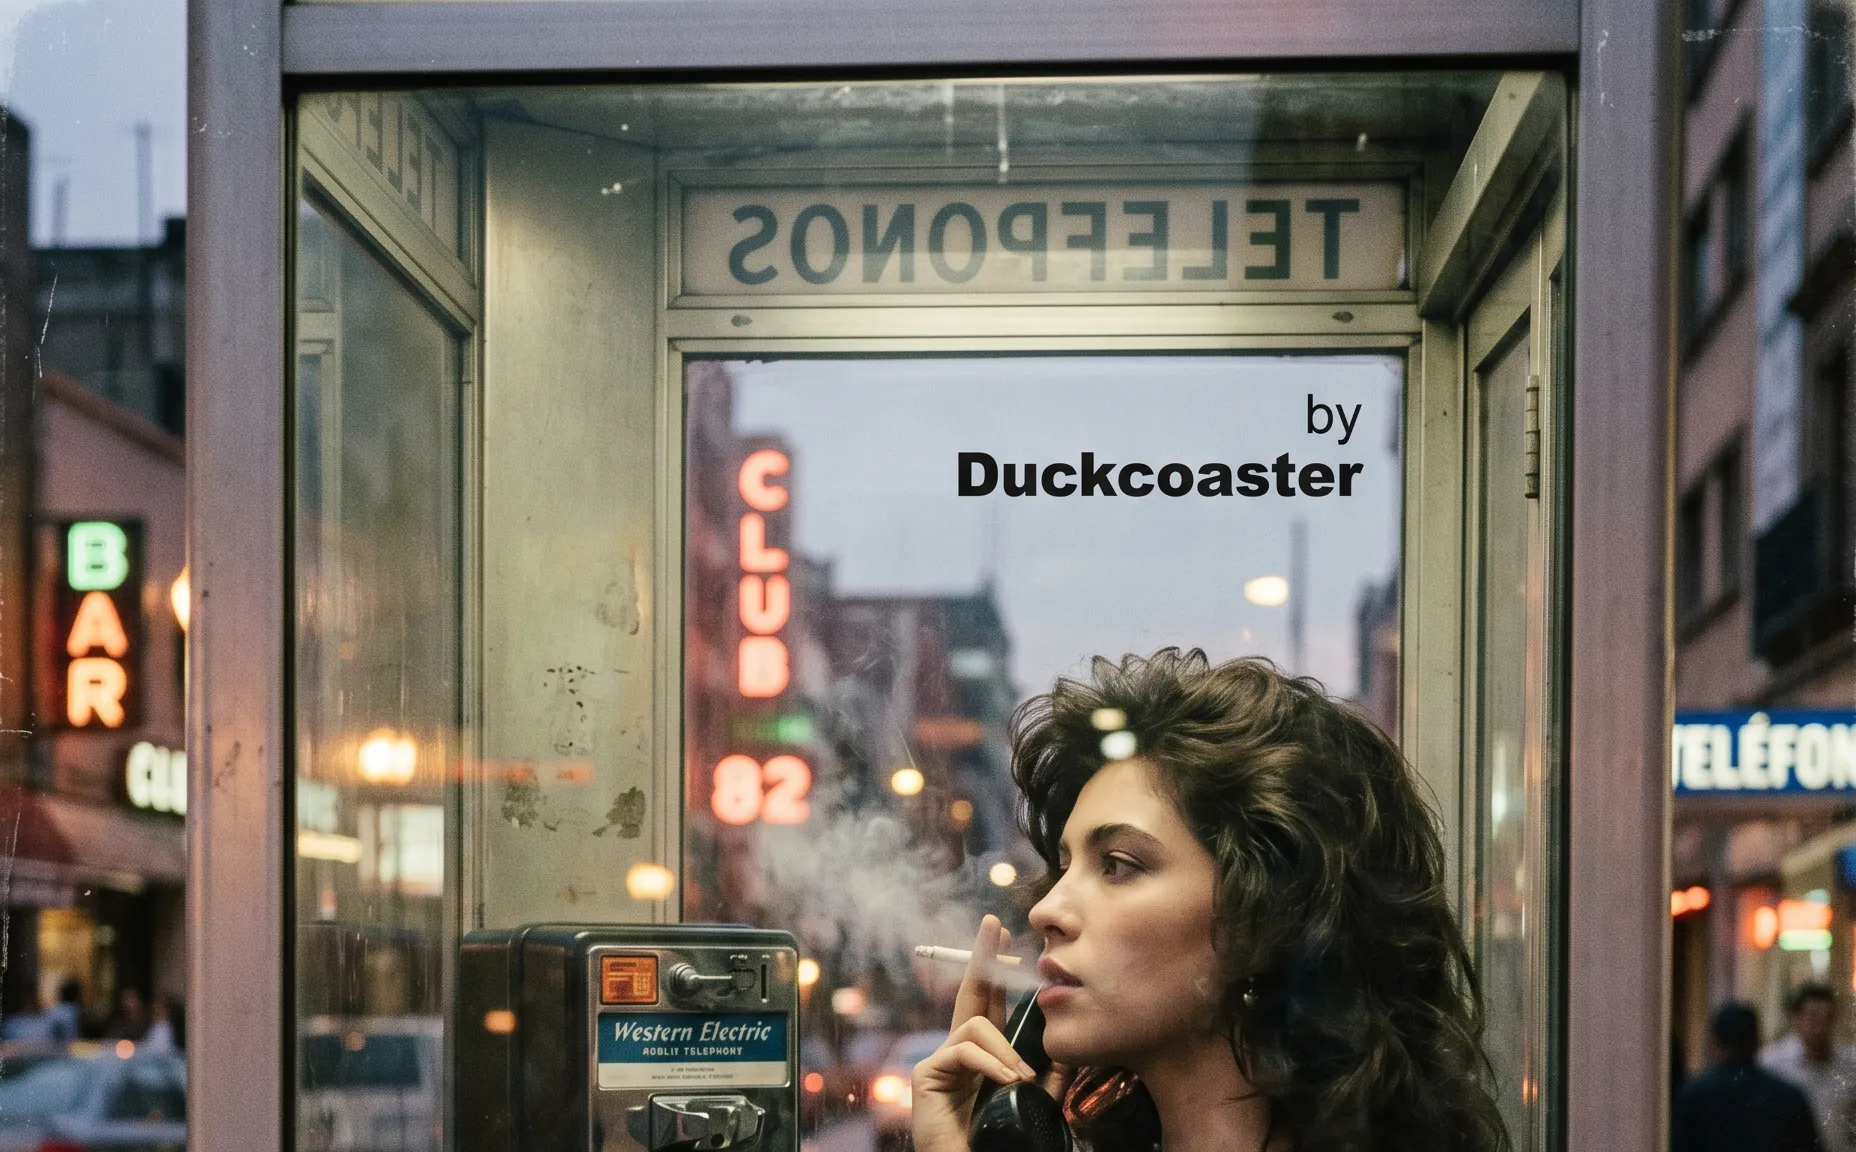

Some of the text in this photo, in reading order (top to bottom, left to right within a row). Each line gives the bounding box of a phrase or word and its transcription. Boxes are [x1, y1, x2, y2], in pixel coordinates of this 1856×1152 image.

[66, 521, 129, 728] BAR
[711, 754, 812, 826] 82
[614, 1020, 772, 1042] Western Electric
